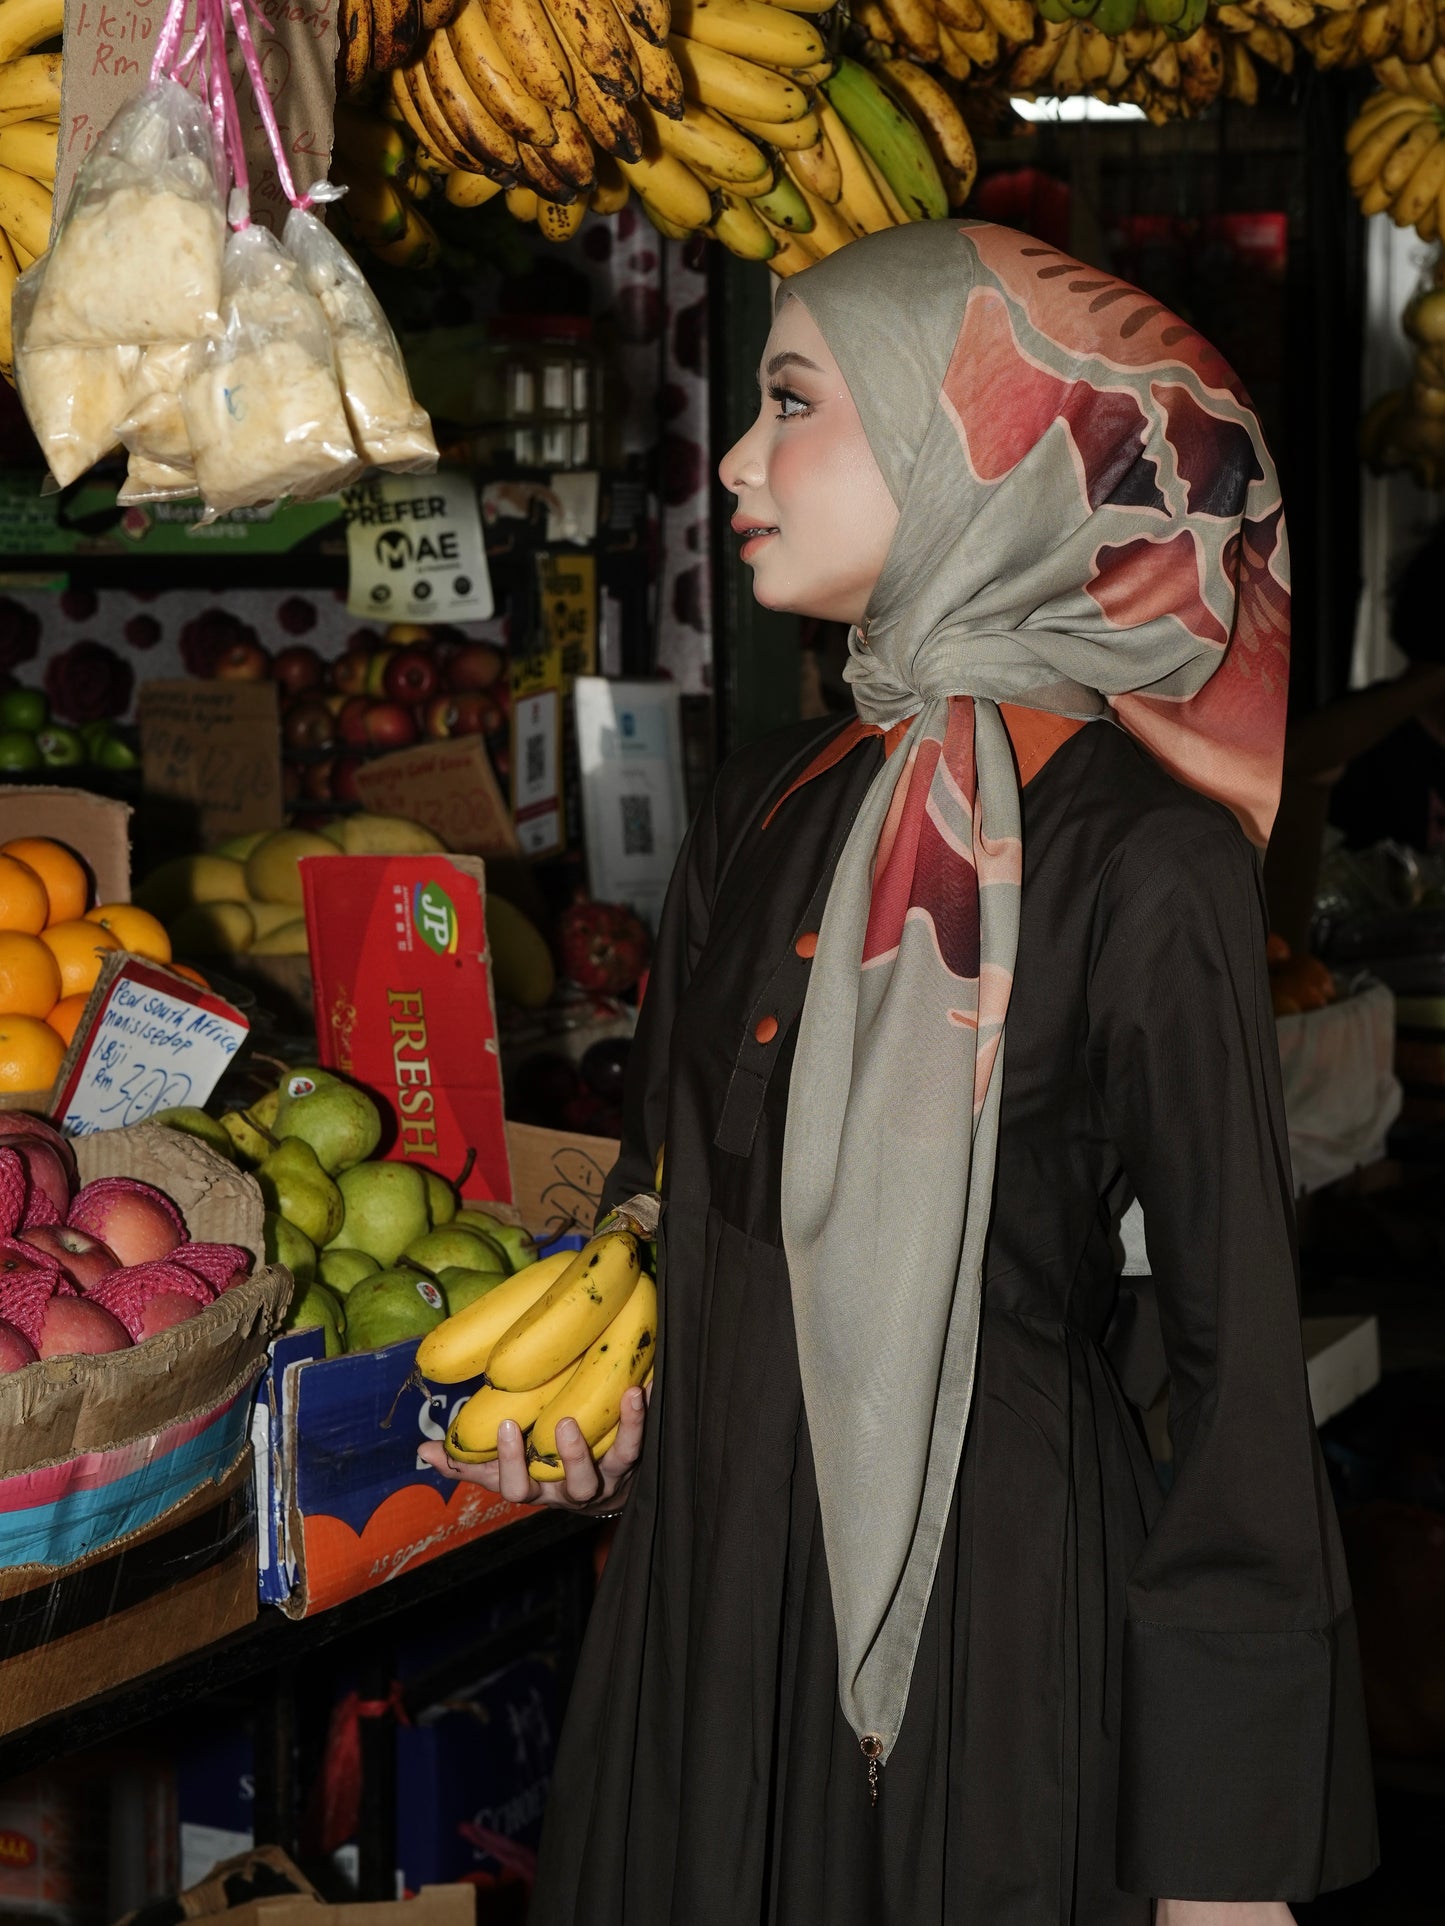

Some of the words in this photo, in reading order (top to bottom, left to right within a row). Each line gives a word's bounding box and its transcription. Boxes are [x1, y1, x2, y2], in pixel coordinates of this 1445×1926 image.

[343, 496, 446, 525] PREFER
[376, 530, 459, 569] MAE
[421, 893, 450, 946] JP
[386, 988, 439, 1159] FRESH
